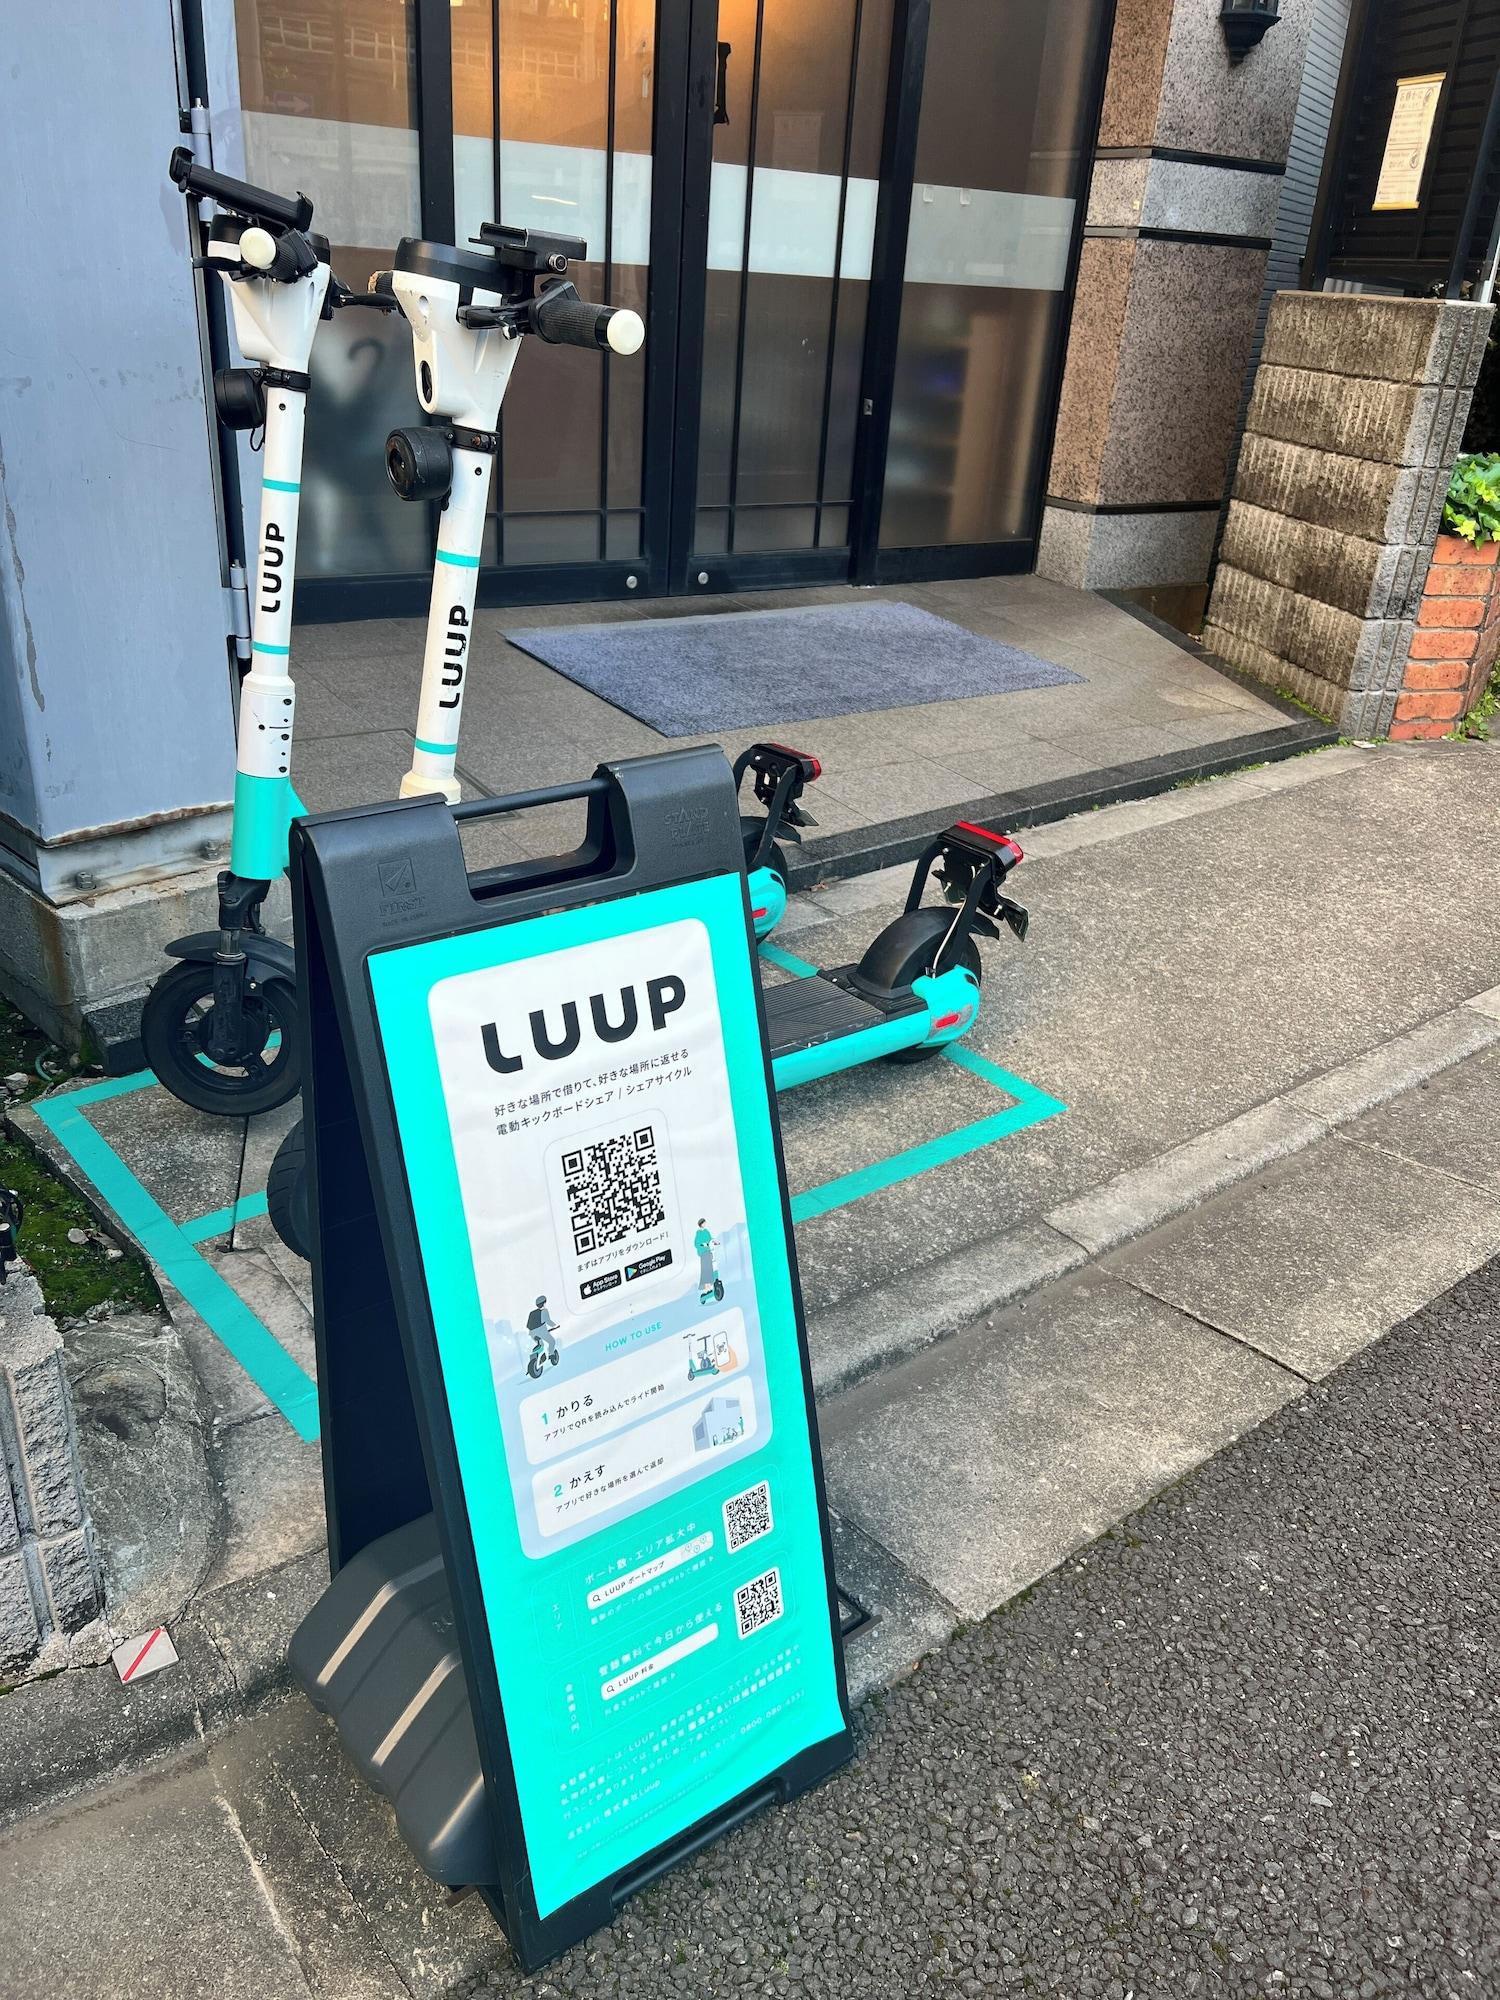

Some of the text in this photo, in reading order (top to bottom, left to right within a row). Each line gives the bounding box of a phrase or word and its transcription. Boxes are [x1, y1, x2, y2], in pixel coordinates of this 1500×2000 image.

[261, 522, 286, 613] LUUP
[439, 605, 469, 709] LUUP
[379, 896, 426, 916] FIRST
[481, 975, 686, 1074] LUUP
[494, 1049, 689, 1117] 好きな場所で借りて、好きな場所に返せる
[497, 1090, 614, 1136] 電動キックボードシェア
[626, 1067, 692, 1095] シェアサイクル
[604, 1274, 619, 1283] Store
[639, 1259, 655, 1270] Google
[605, 1322, 663, 1351] HOW TO USE
[541, 1394, 594, 1425] 1 かりる
[544, 1384, 665, 1442] アプリでQRを読み込んでライド開始
[553, 1465, 606, 1497] 2 かえす
[604, 1581, 627, 1597] LUUP
[617, 1672, 639, 1687] LUUP
